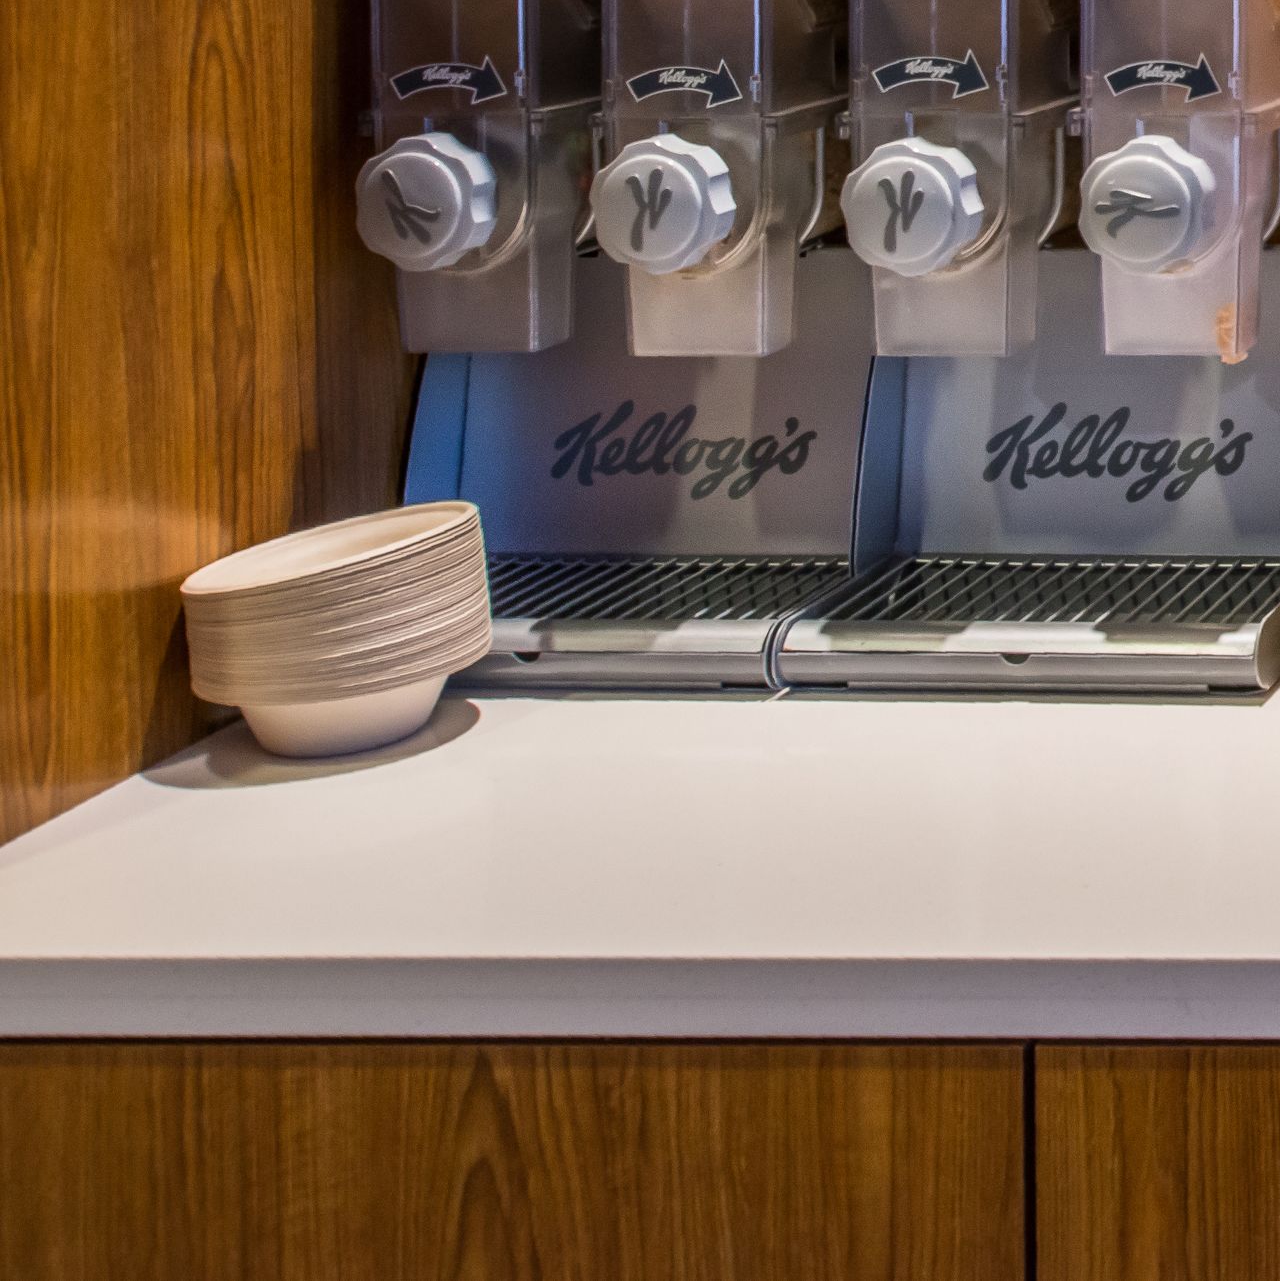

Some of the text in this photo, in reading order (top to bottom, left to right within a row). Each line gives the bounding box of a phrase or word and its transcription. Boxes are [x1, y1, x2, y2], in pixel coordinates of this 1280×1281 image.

[422, 67, 472, 84] Kellogg's
[658, 69, 707, 87] Kellogg's
[905, 59, 954, 78] Kellogg's
[1136, 64, 1186, 83] Kellogg's
[551, 400, 817, 501] Kellogg's
[982, 401, 1255, 504] Kellogg's
